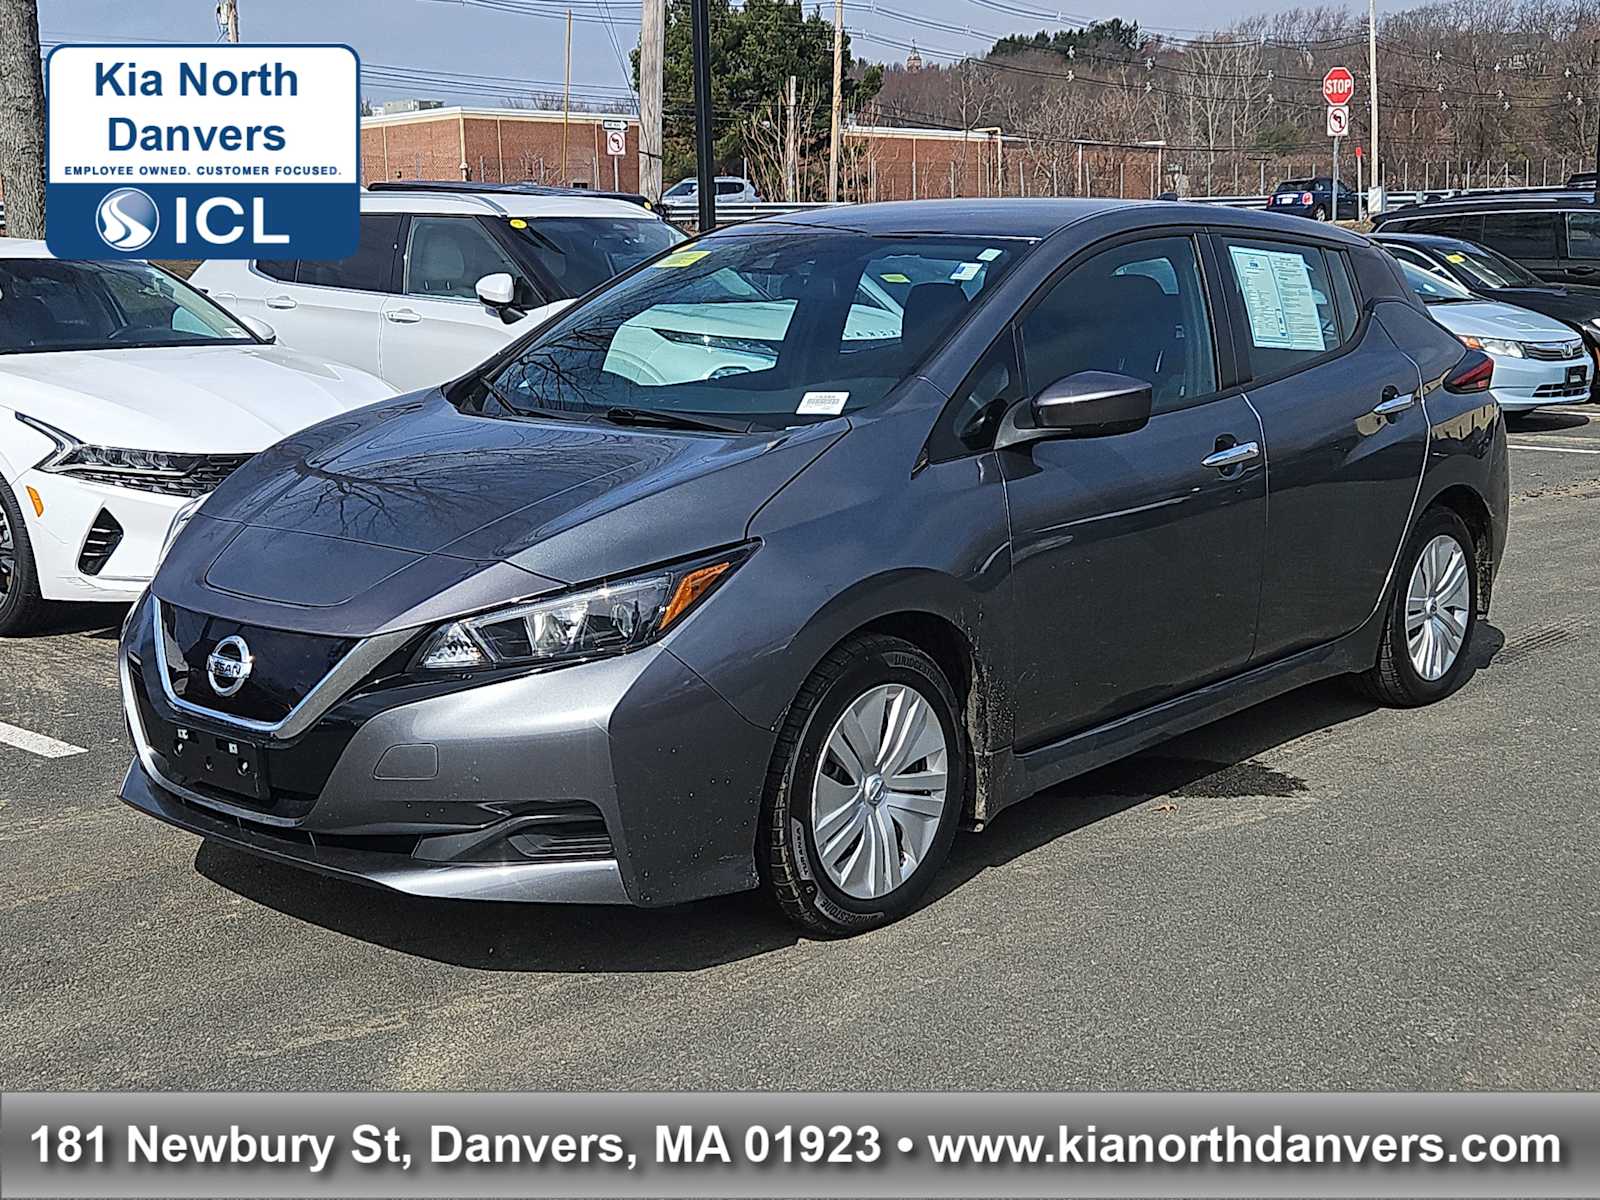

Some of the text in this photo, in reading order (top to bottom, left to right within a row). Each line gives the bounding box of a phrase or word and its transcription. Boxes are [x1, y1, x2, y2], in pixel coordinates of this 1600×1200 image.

[1325, 78, 1351, 94] STOP
[893, 653, 942, 685] BRIDGESTON
[820, 898, 878, 925] IDGESTONE
